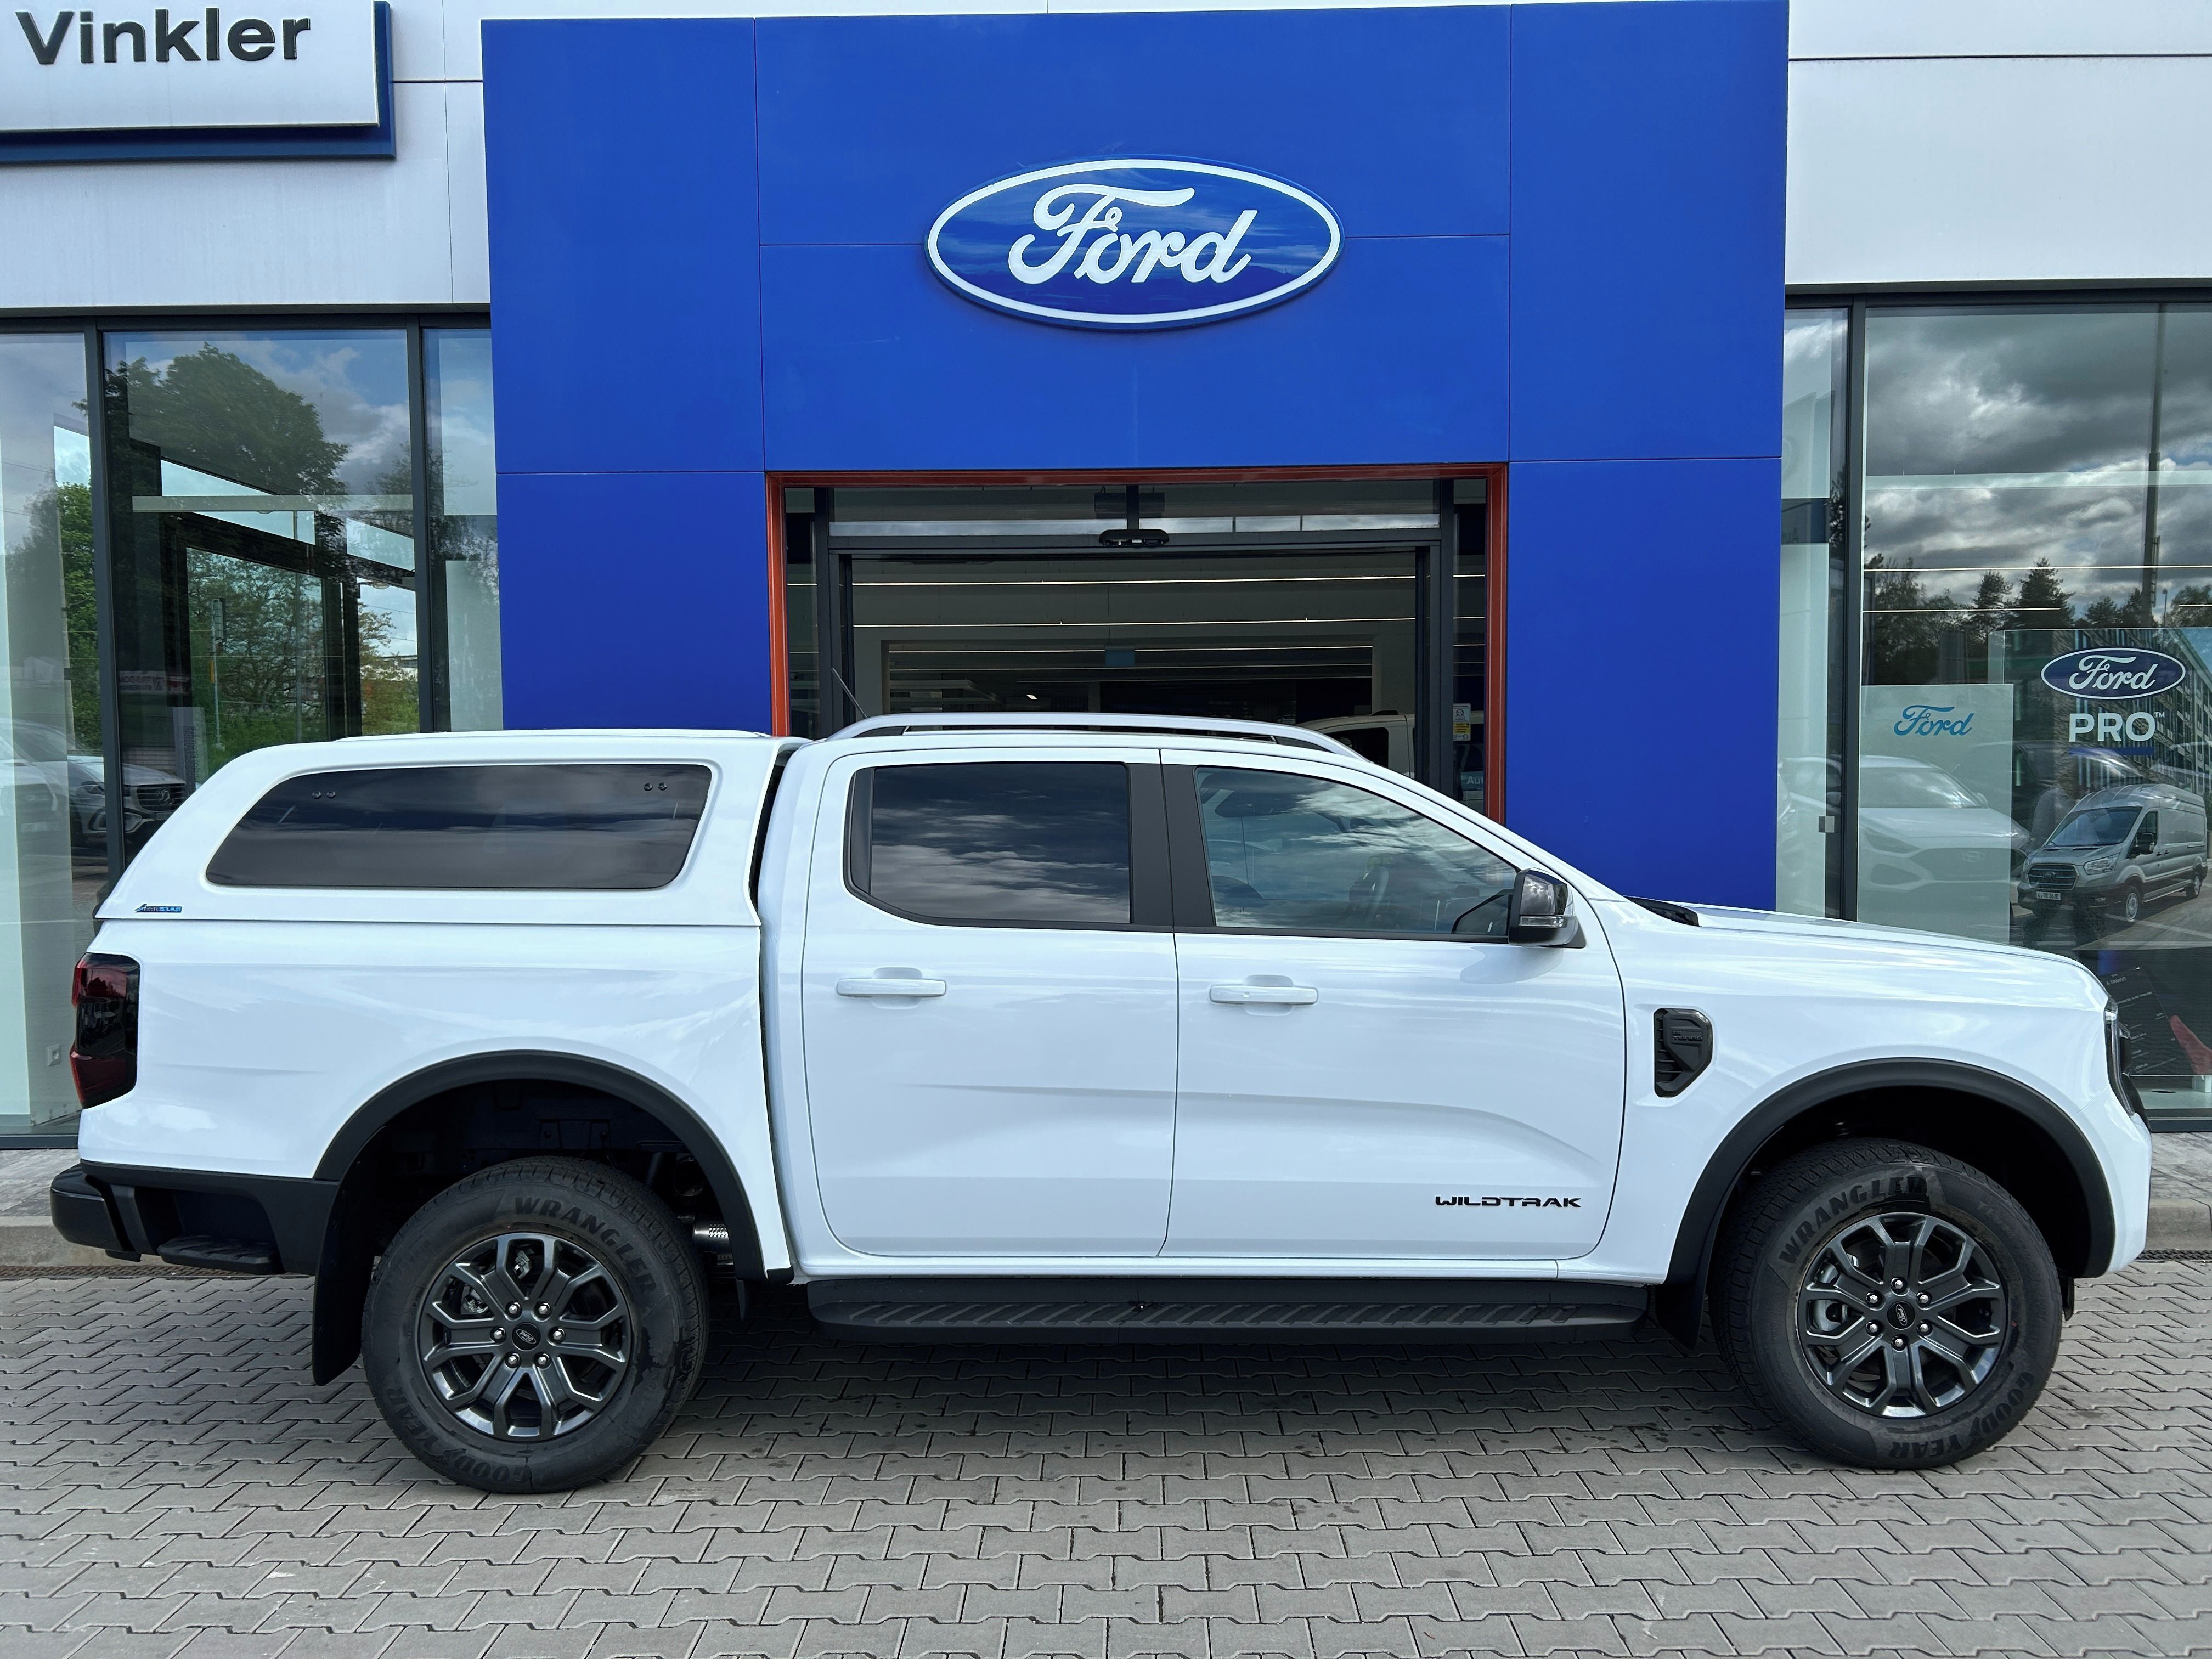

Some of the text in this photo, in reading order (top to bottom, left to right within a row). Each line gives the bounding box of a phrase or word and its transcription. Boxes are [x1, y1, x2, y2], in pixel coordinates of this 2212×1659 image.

[15, 7, 311, 65] Vinkler
[1008, 183, 1259, 285] Ford
[2069, 654, 2159, 690] Ford
[1893, 704, 1975, 736] Ford
[1435, 1196, 1582, 1207] WILDTRAK
[1779, 1176, 1928, 1267] WRANGLER
[514, 1195, 659, 1295] WRANGLER
